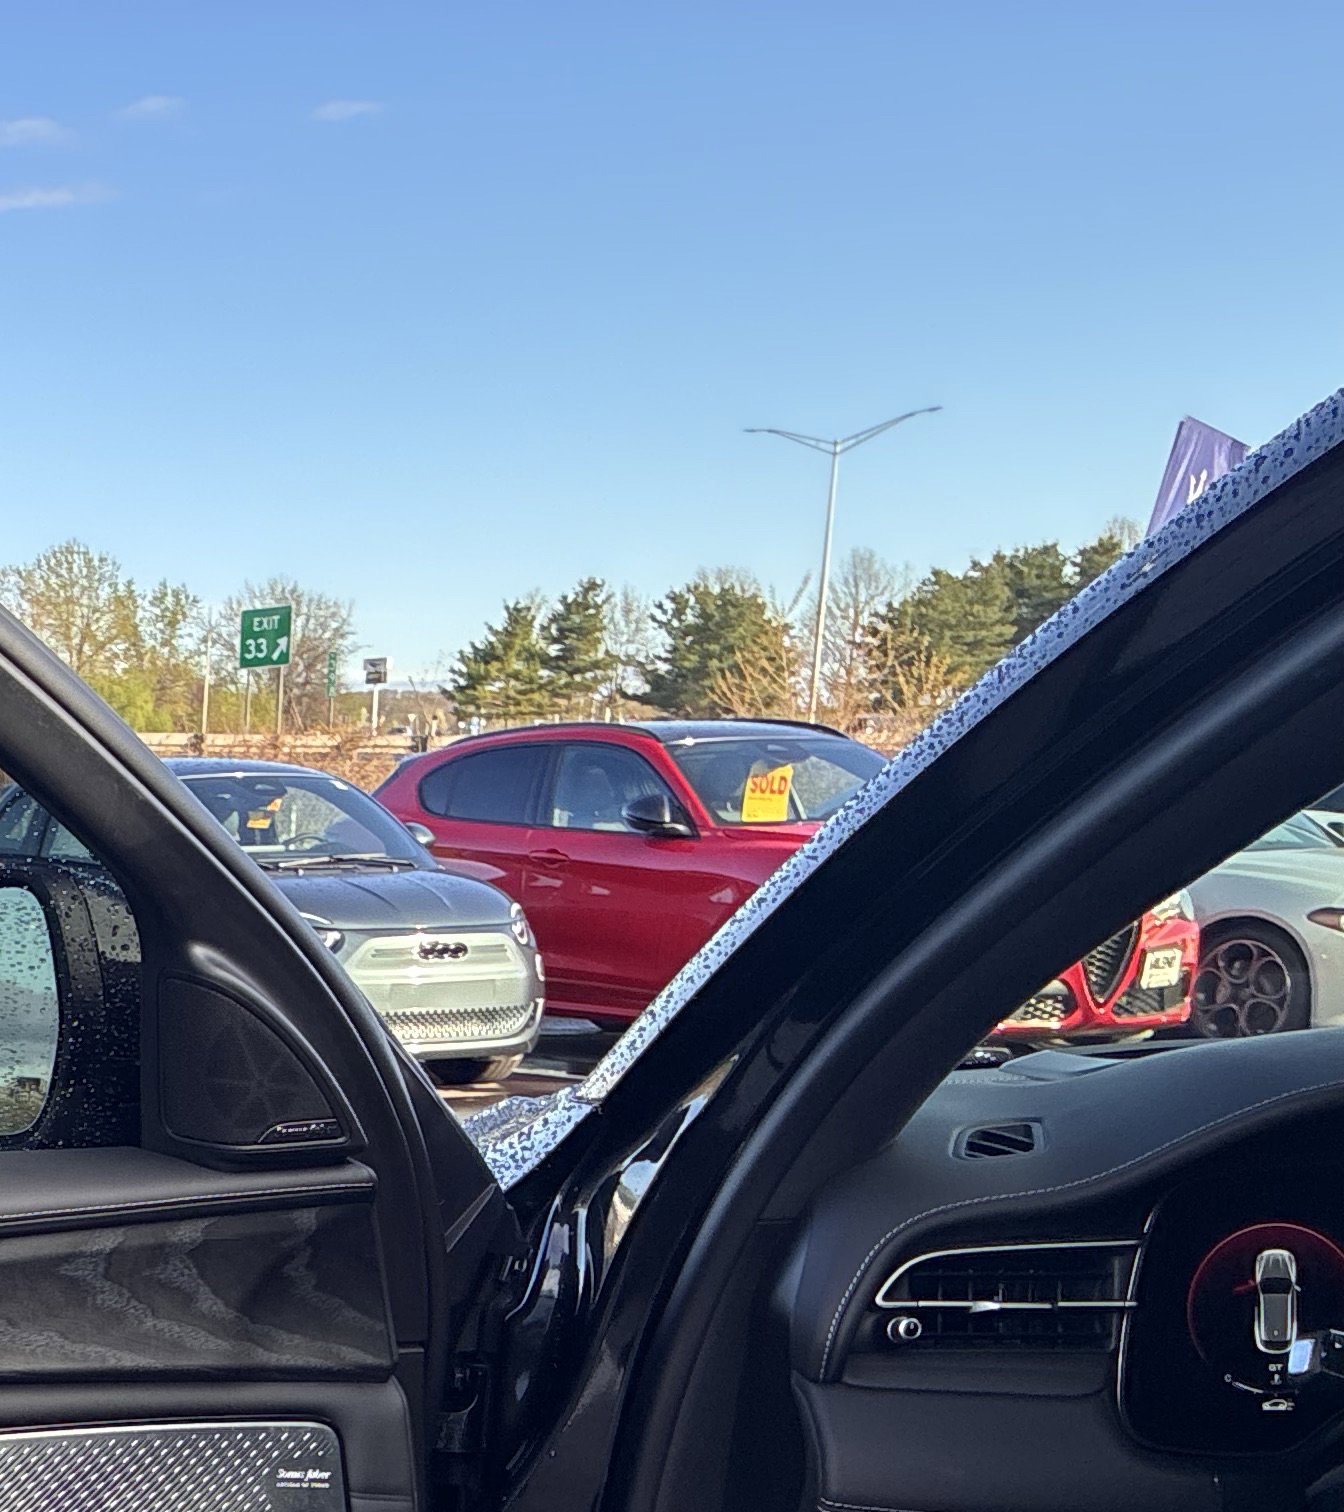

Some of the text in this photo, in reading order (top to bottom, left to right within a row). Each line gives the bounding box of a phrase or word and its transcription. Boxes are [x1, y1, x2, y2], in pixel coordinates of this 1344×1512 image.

[253, 615, 280, 632] EXIT
[244, 638, 268, 660] 33
[750, 774, 788, 795] SOLD
